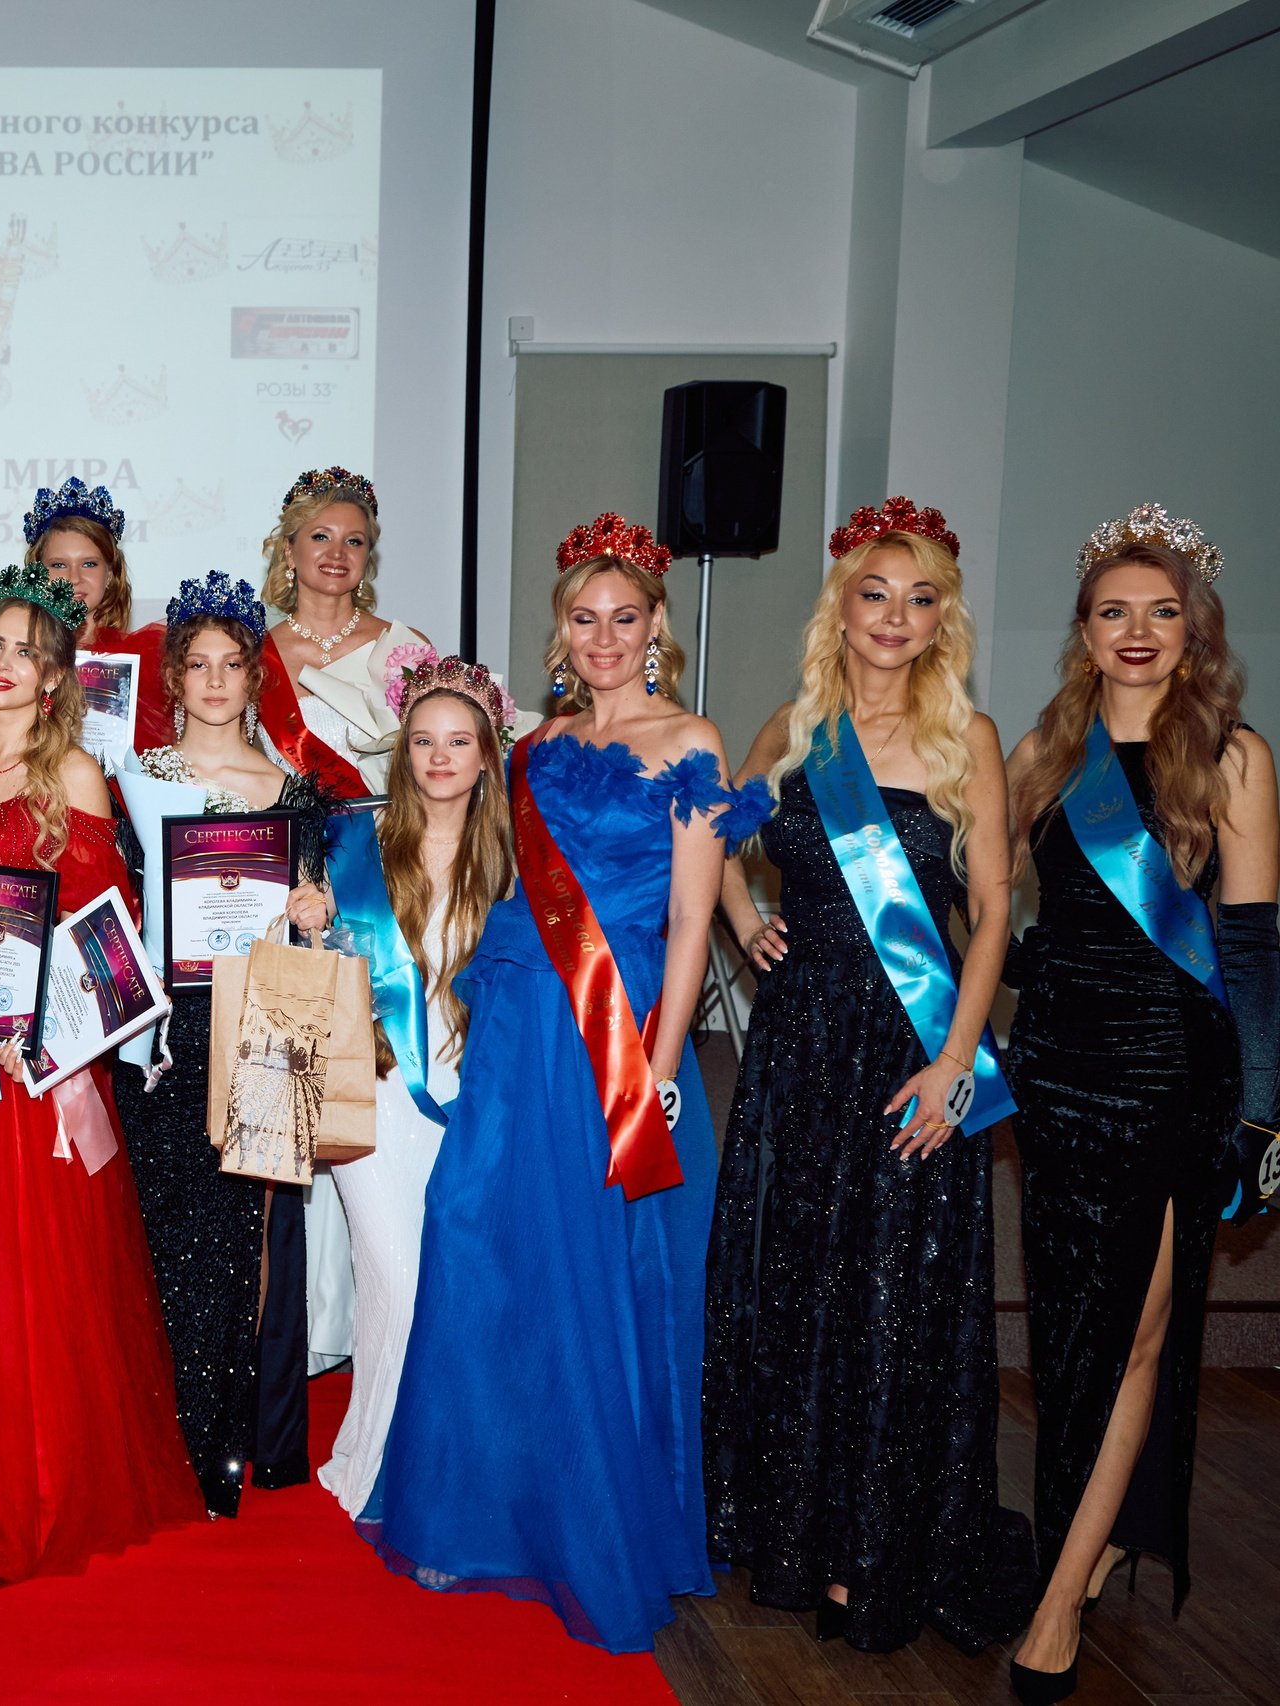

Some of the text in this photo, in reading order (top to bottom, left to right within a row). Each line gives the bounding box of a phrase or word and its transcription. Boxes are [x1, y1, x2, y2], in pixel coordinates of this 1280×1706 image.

[93, 115, 259, 141] конкурса
[256, 382, 306, 397] РОЗЫ
[184, 826, 274, 844] CERTIFICATE
[862, 823, 907, 908] Королева
[547, 866, 596, 954] Королева
[102, 917, 145, 1001] CERTIFICATE
[896, 947, 937, 976] 2025
[659, 1091, 677, 1122] 2
[948, 1079, 972, 1118] 11
